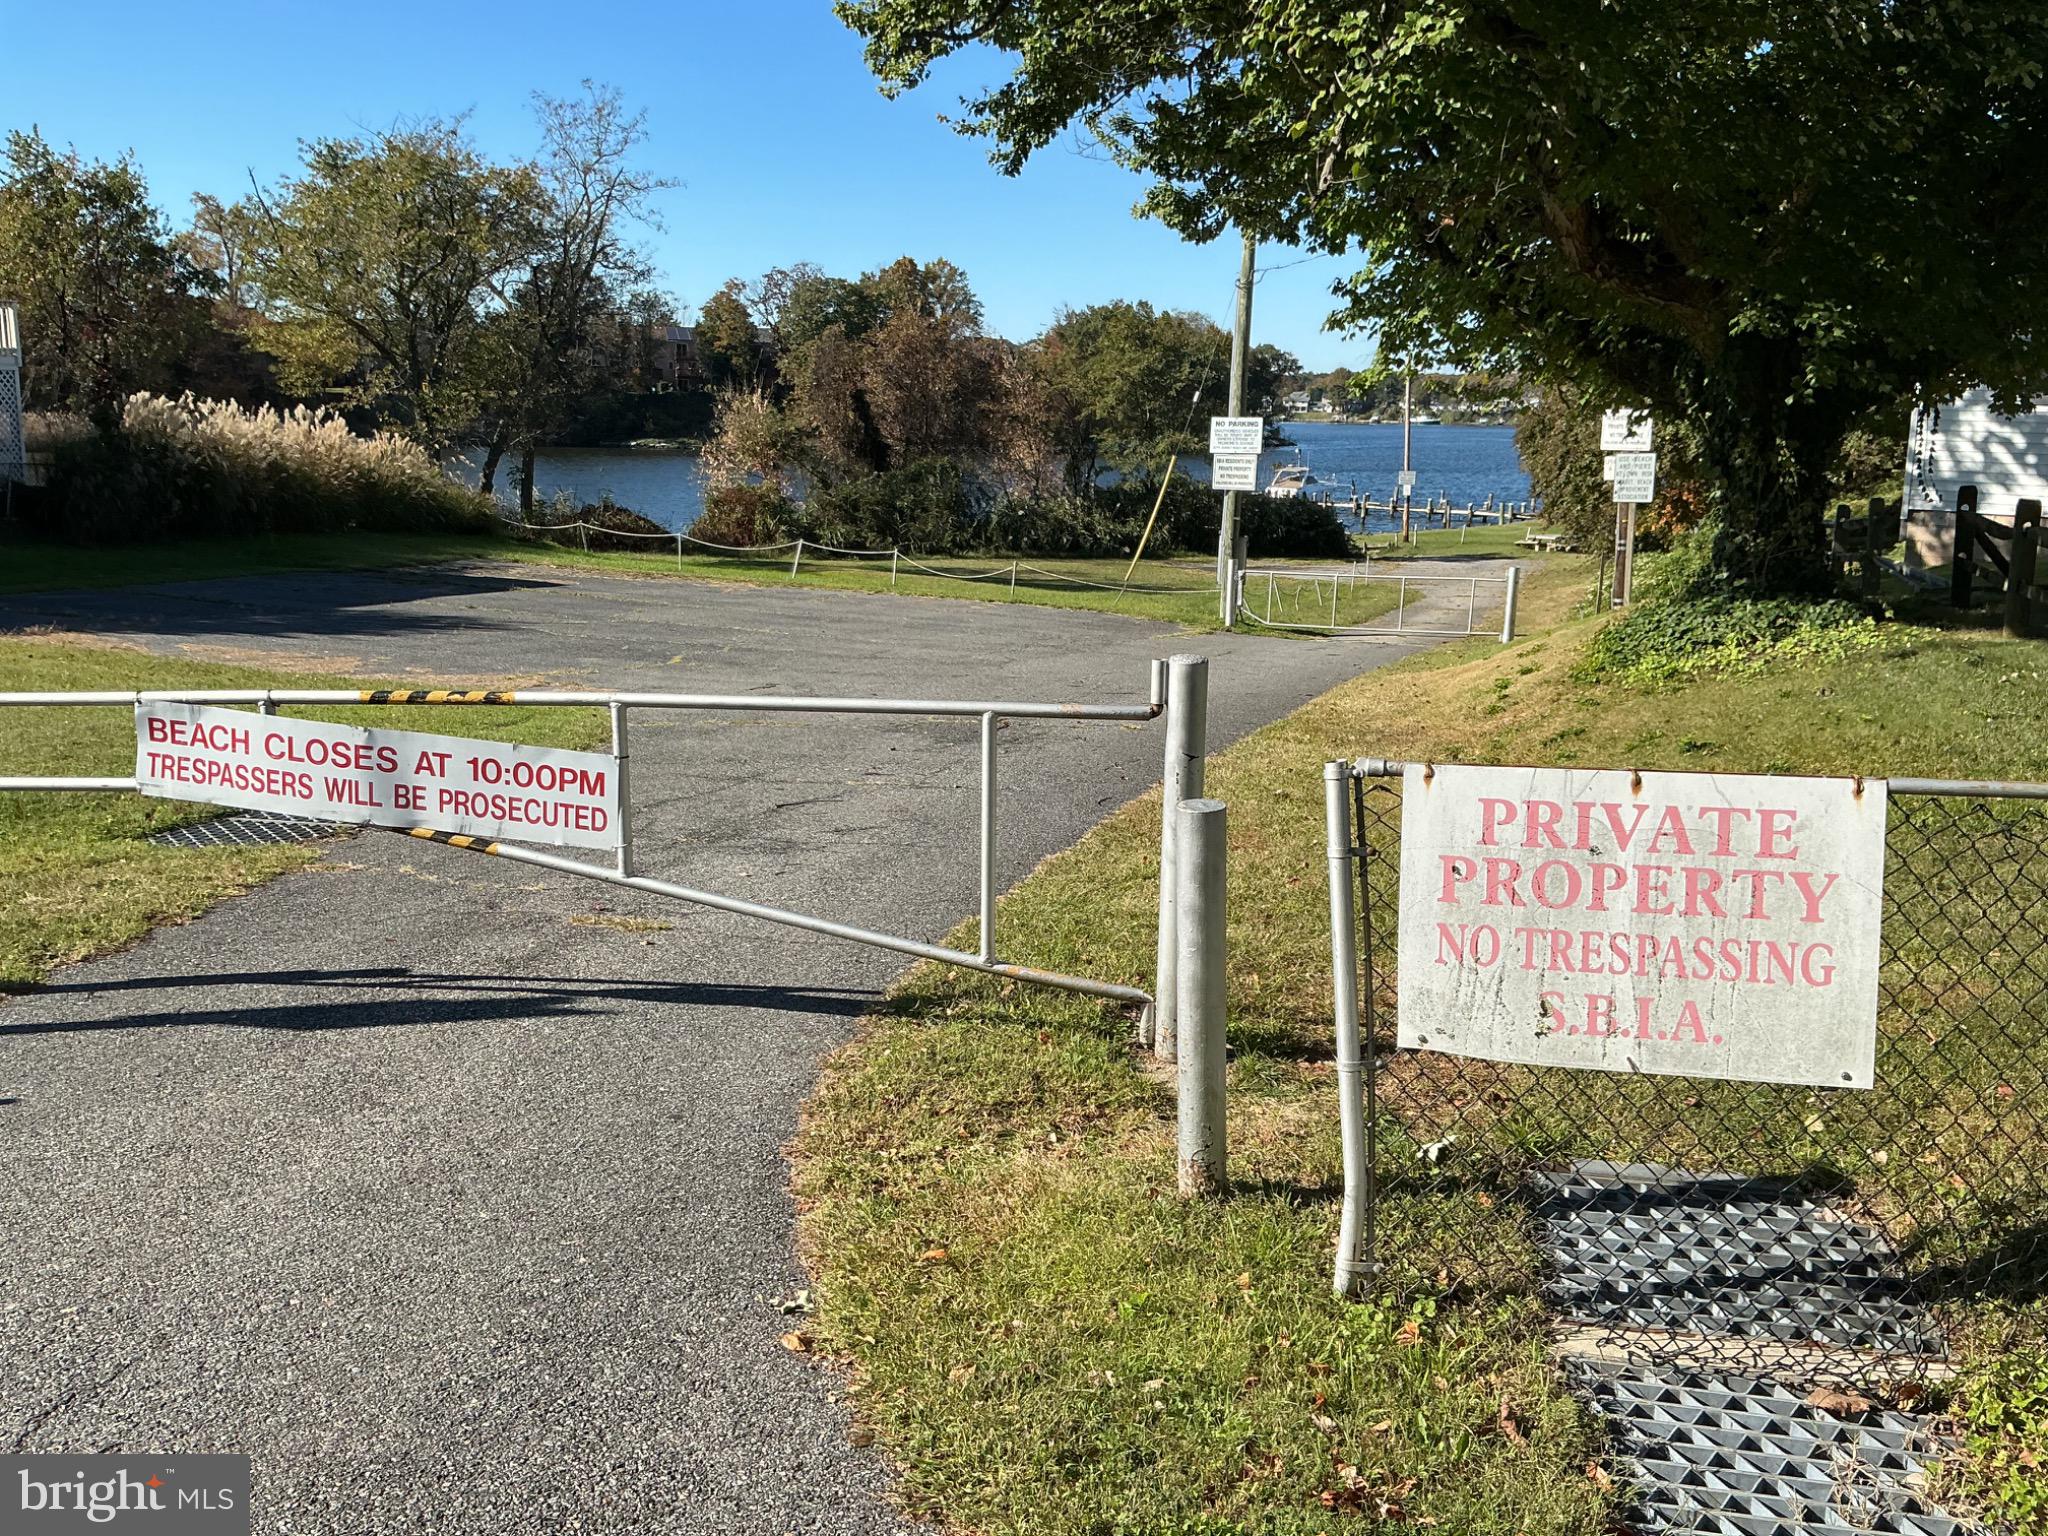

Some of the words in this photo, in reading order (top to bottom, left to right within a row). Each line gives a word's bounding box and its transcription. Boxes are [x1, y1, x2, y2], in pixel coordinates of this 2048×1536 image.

[147, 717, 250, 756] BEACH
[264, 733, 399, 773] CLOSES
[414, 750, 453, 778] AT
[467, 757, 606, 798] 10:00PM
[146, 752, 313, 800] TRESPASSERS
[324, 776, 382, 808] WILL
[394, 784, 427, 812] BE
[439, 788, 608, 833] PROSECUTED
[1477, 796, 1800, 861] PRIVATE
[1436, 854, 1840, 924] PROPERTY
[1434, 922, 1501, 968] NO
[1515, 926, 1837, 988] TRESPASSING
[1539, 990, 1725, 1046] S.B.I.A.
